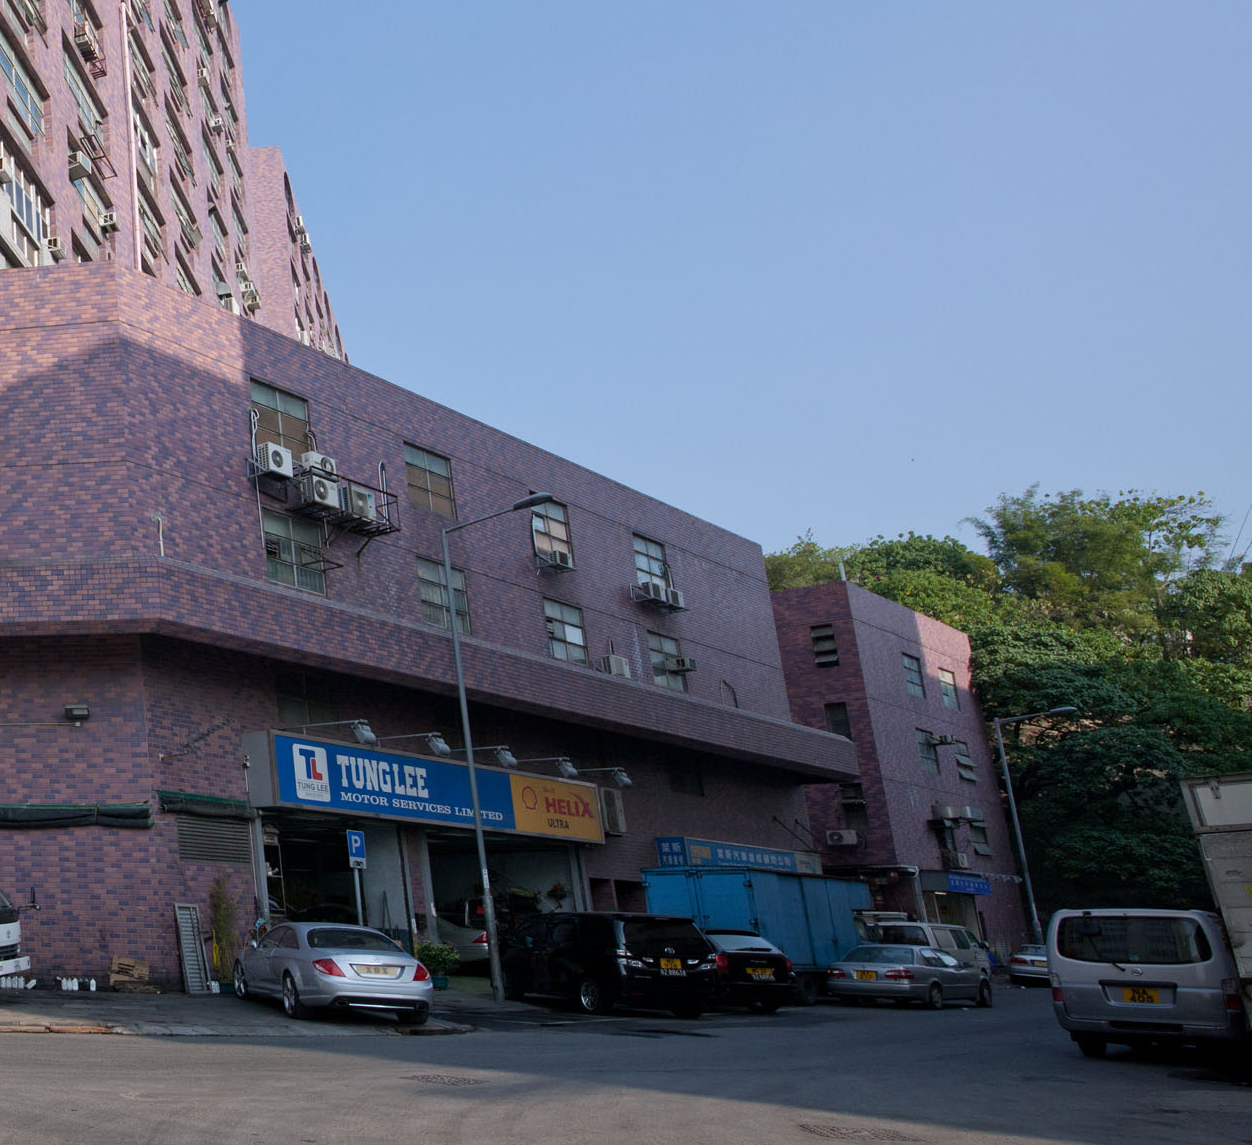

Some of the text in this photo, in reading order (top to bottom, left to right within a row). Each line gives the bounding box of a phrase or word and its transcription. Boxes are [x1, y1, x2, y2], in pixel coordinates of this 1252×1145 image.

[297, 781, 329, 793] TUNG LEE
[340, 792, 504, 821] MOTOR SERVICES LIMTED
[544, 795, 594, 819] HELIX
[547, 818, 570, 830] ULTRA
[351, 835, 361, 853] P
